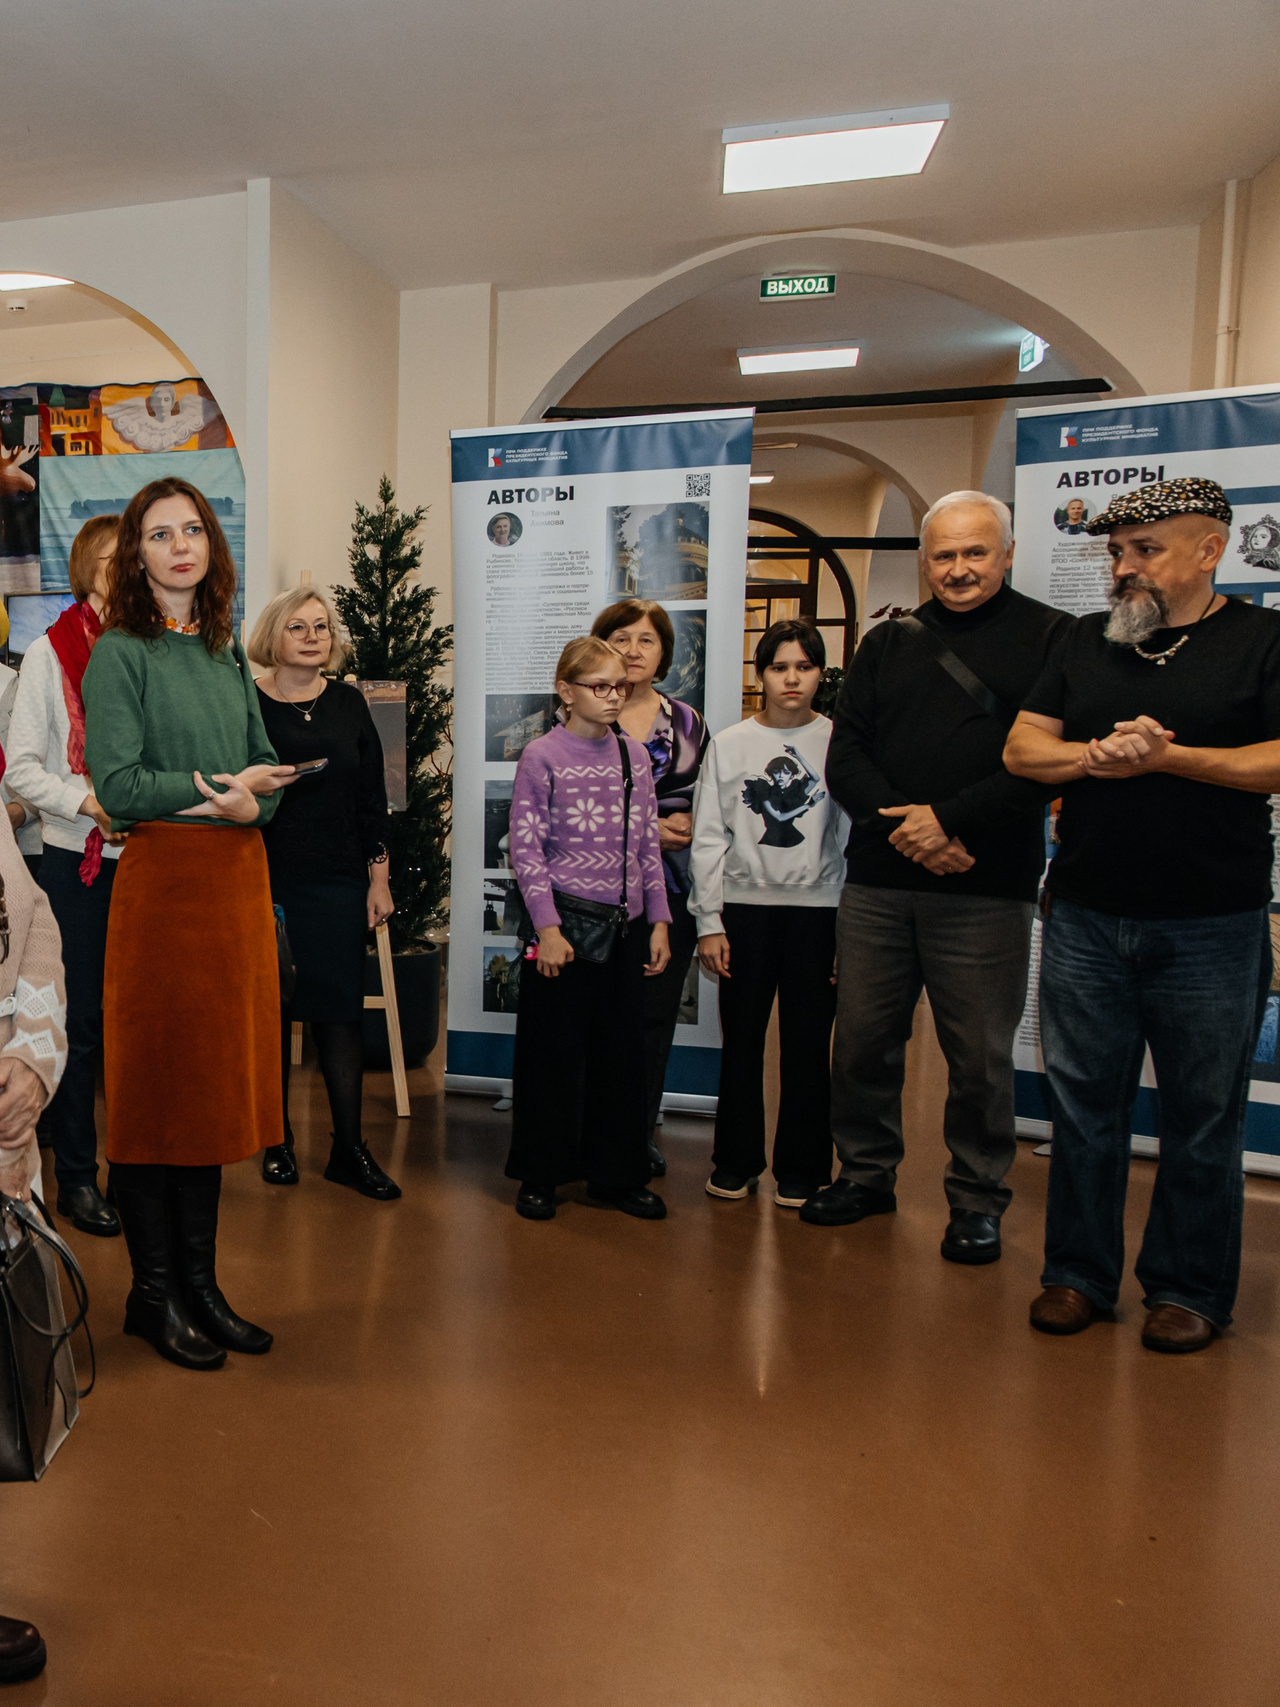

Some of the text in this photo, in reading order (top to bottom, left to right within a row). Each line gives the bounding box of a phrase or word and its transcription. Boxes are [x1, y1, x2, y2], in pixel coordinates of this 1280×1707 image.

[767, 277, 828, 295] ВЫХОД
[1056, 465, 1164, 488] АВТОРЫ
[487, 486, 574, 505] АВТОРЫ
